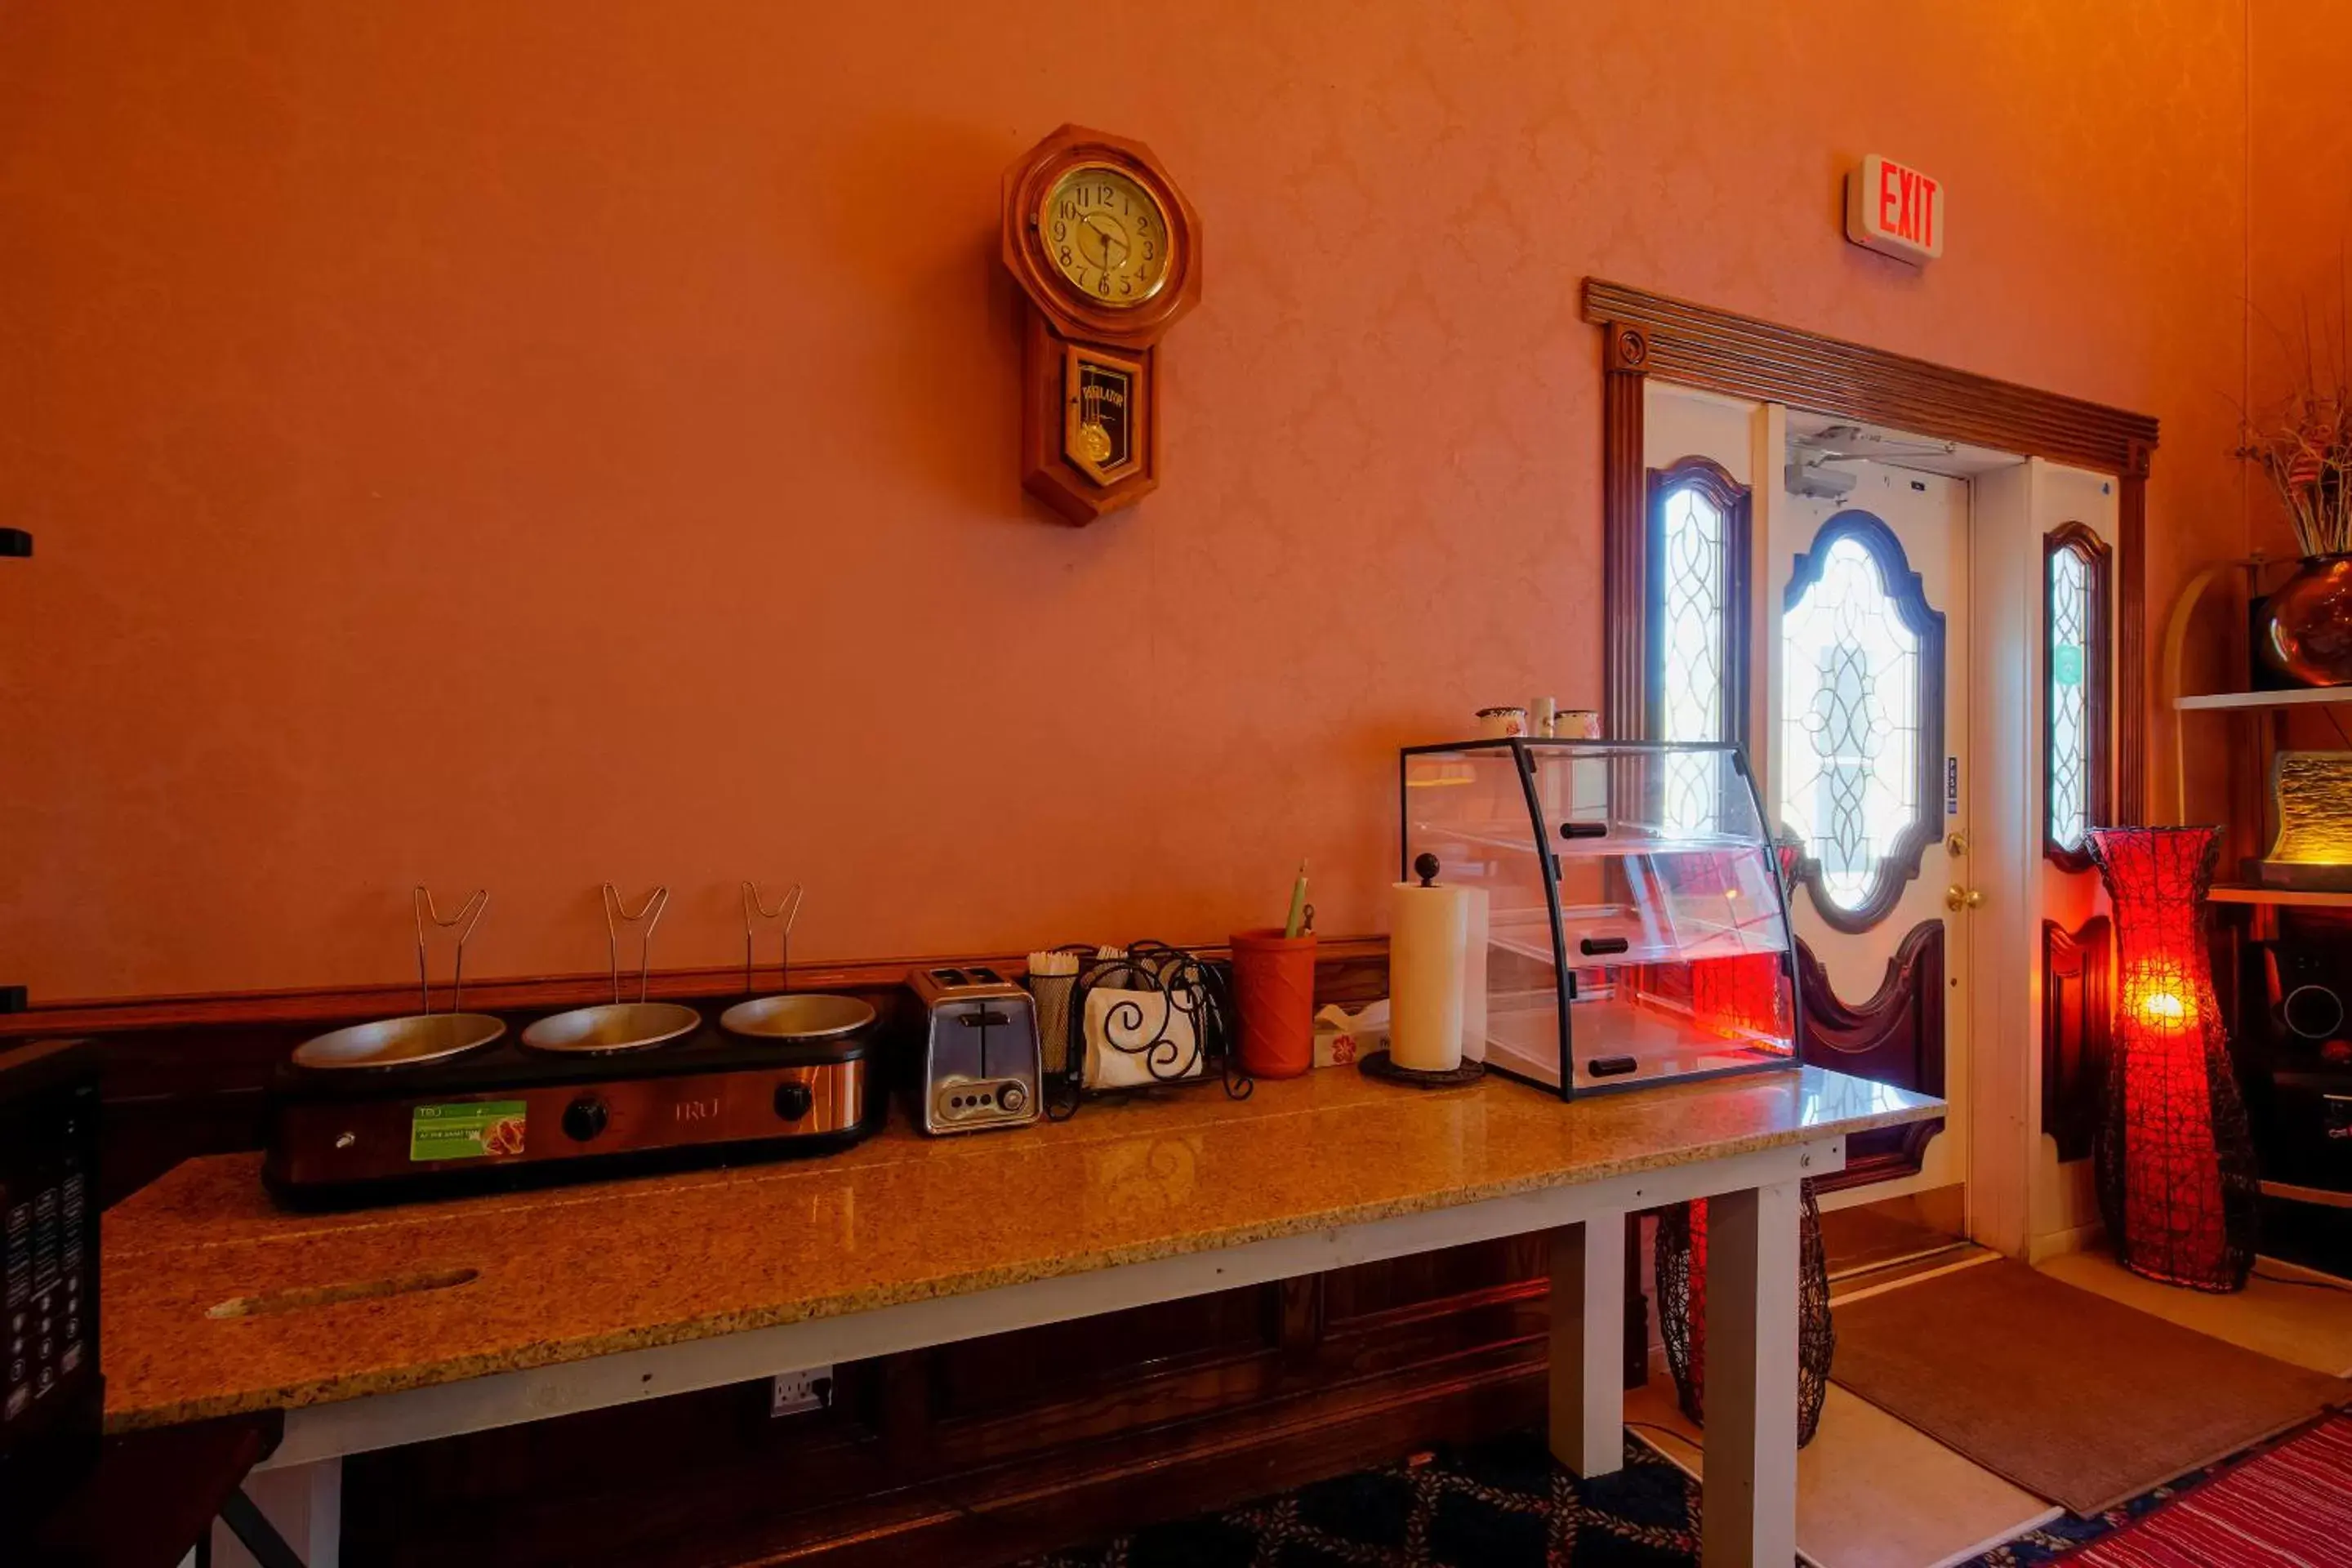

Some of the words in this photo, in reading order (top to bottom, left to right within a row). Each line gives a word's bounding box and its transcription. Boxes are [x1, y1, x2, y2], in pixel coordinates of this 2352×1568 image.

[1076, 187, 1089, 207] 11
[1098, 185, 1114, 207] 12
[1124, 197, 1129, 216] 1
[1880, 161, 1936, 248] EXIT
[1060, 200, 1076, 220] 10
[1054, 220, 1066, 243] 9
[1137, 216, 1148, 238] 2
[1060, 245, 1071, 267] 8
[1141, 240, 1153, 261] 3
[1076, 265, 1088, 286] 7
[1098, 272, 1110, 295] 6
[1134, 264, 1147, 282] 4
[1120, 275, 1131, 295] 5
[1081, 385, 1124, 408] LATOR
